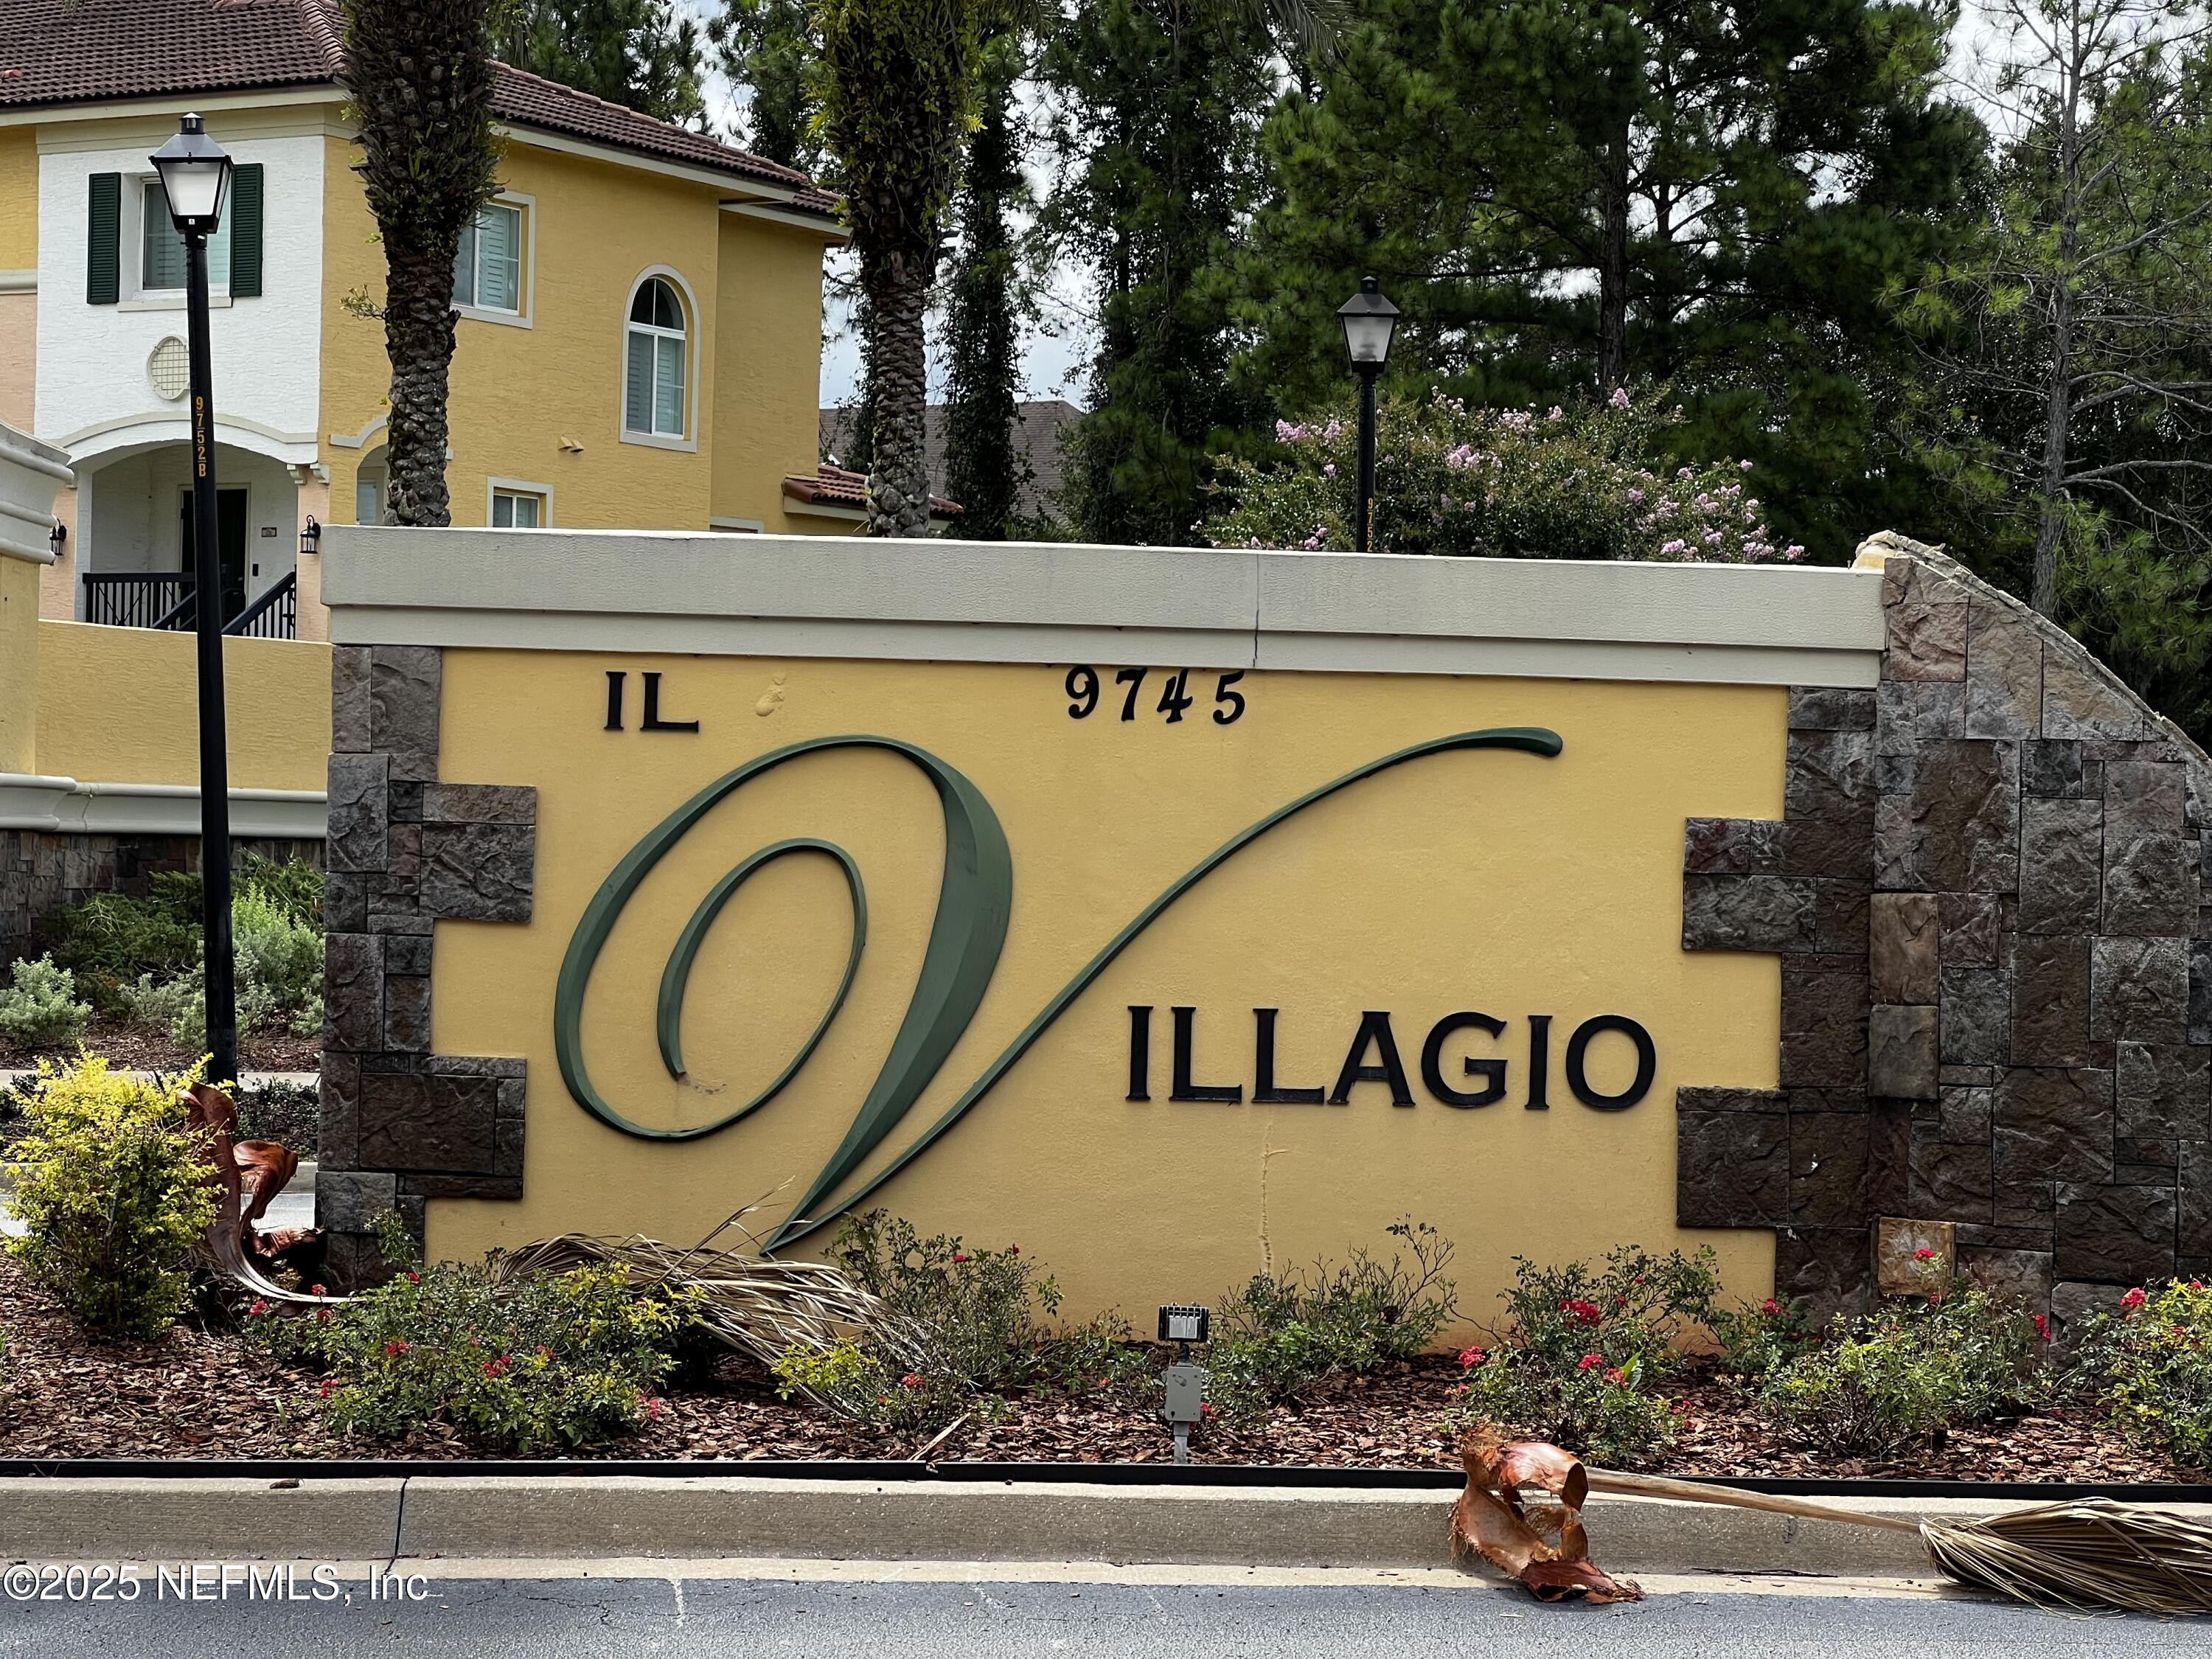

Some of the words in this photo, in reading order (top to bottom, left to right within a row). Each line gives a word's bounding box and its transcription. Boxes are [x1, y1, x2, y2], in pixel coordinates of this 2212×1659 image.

[195, 396, 206, 477] 9752B
[603, 670, 700, 733] IL
[1064, 664, 1247, 726] 9745
